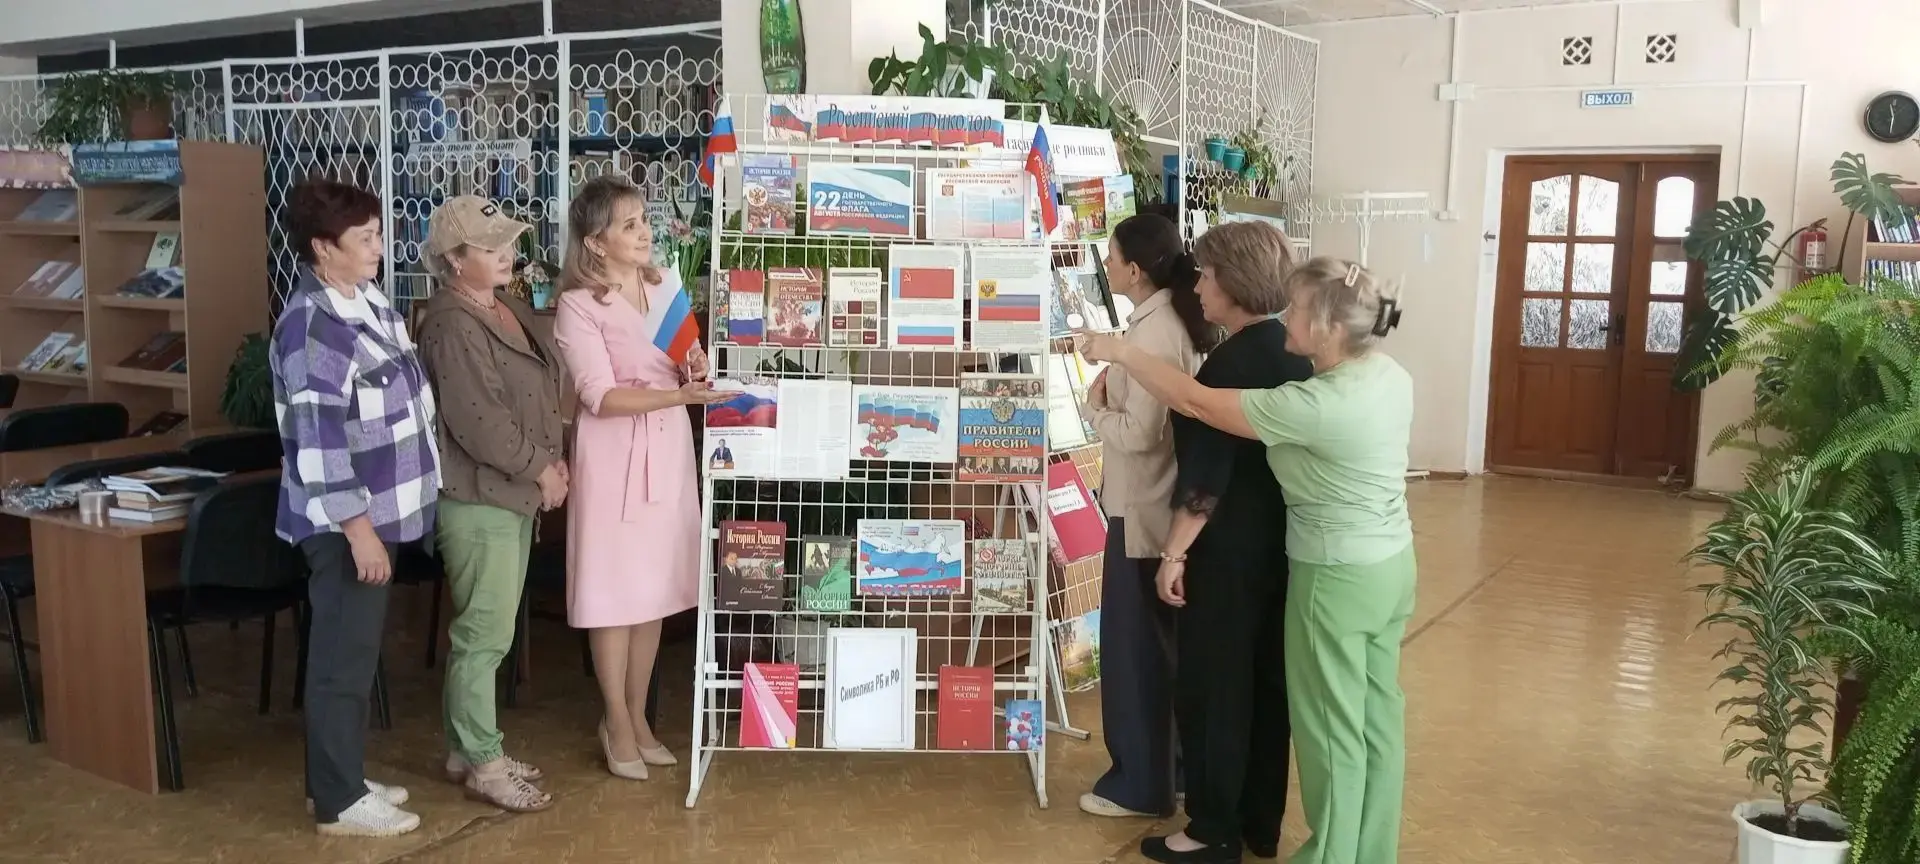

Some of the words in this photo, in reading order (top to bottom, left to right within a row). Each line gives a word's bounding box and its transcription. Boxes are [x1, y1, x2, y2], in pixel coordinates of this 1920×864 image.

[1586, 93, 1630, 105] ВЫХОД
[828, 103, 910, 131] Российский
[921, 112, 992, 138] триколор
[813, 190, 842, 211] 22
[841, 191, 866, 200] ДЕНЬ
[813, 209, 842, 218] АВГУСТА
[841, 205, 870, 213] ФЛАГА
[963, 425, 1041, 436] ПРАВИТЕЛИ
[974, 438, 1029, 449] РОССИИ
[726, 529, 755, 549] История
[757, 530, 781, 545] России
[806, 600, 848, 609] РОССИИ
[840, 681, 874, 703] Символика
[875, 673, 884, 690] РБ
[885, 678, 890, 686] и
[890, 668, 900, 687] РФ
